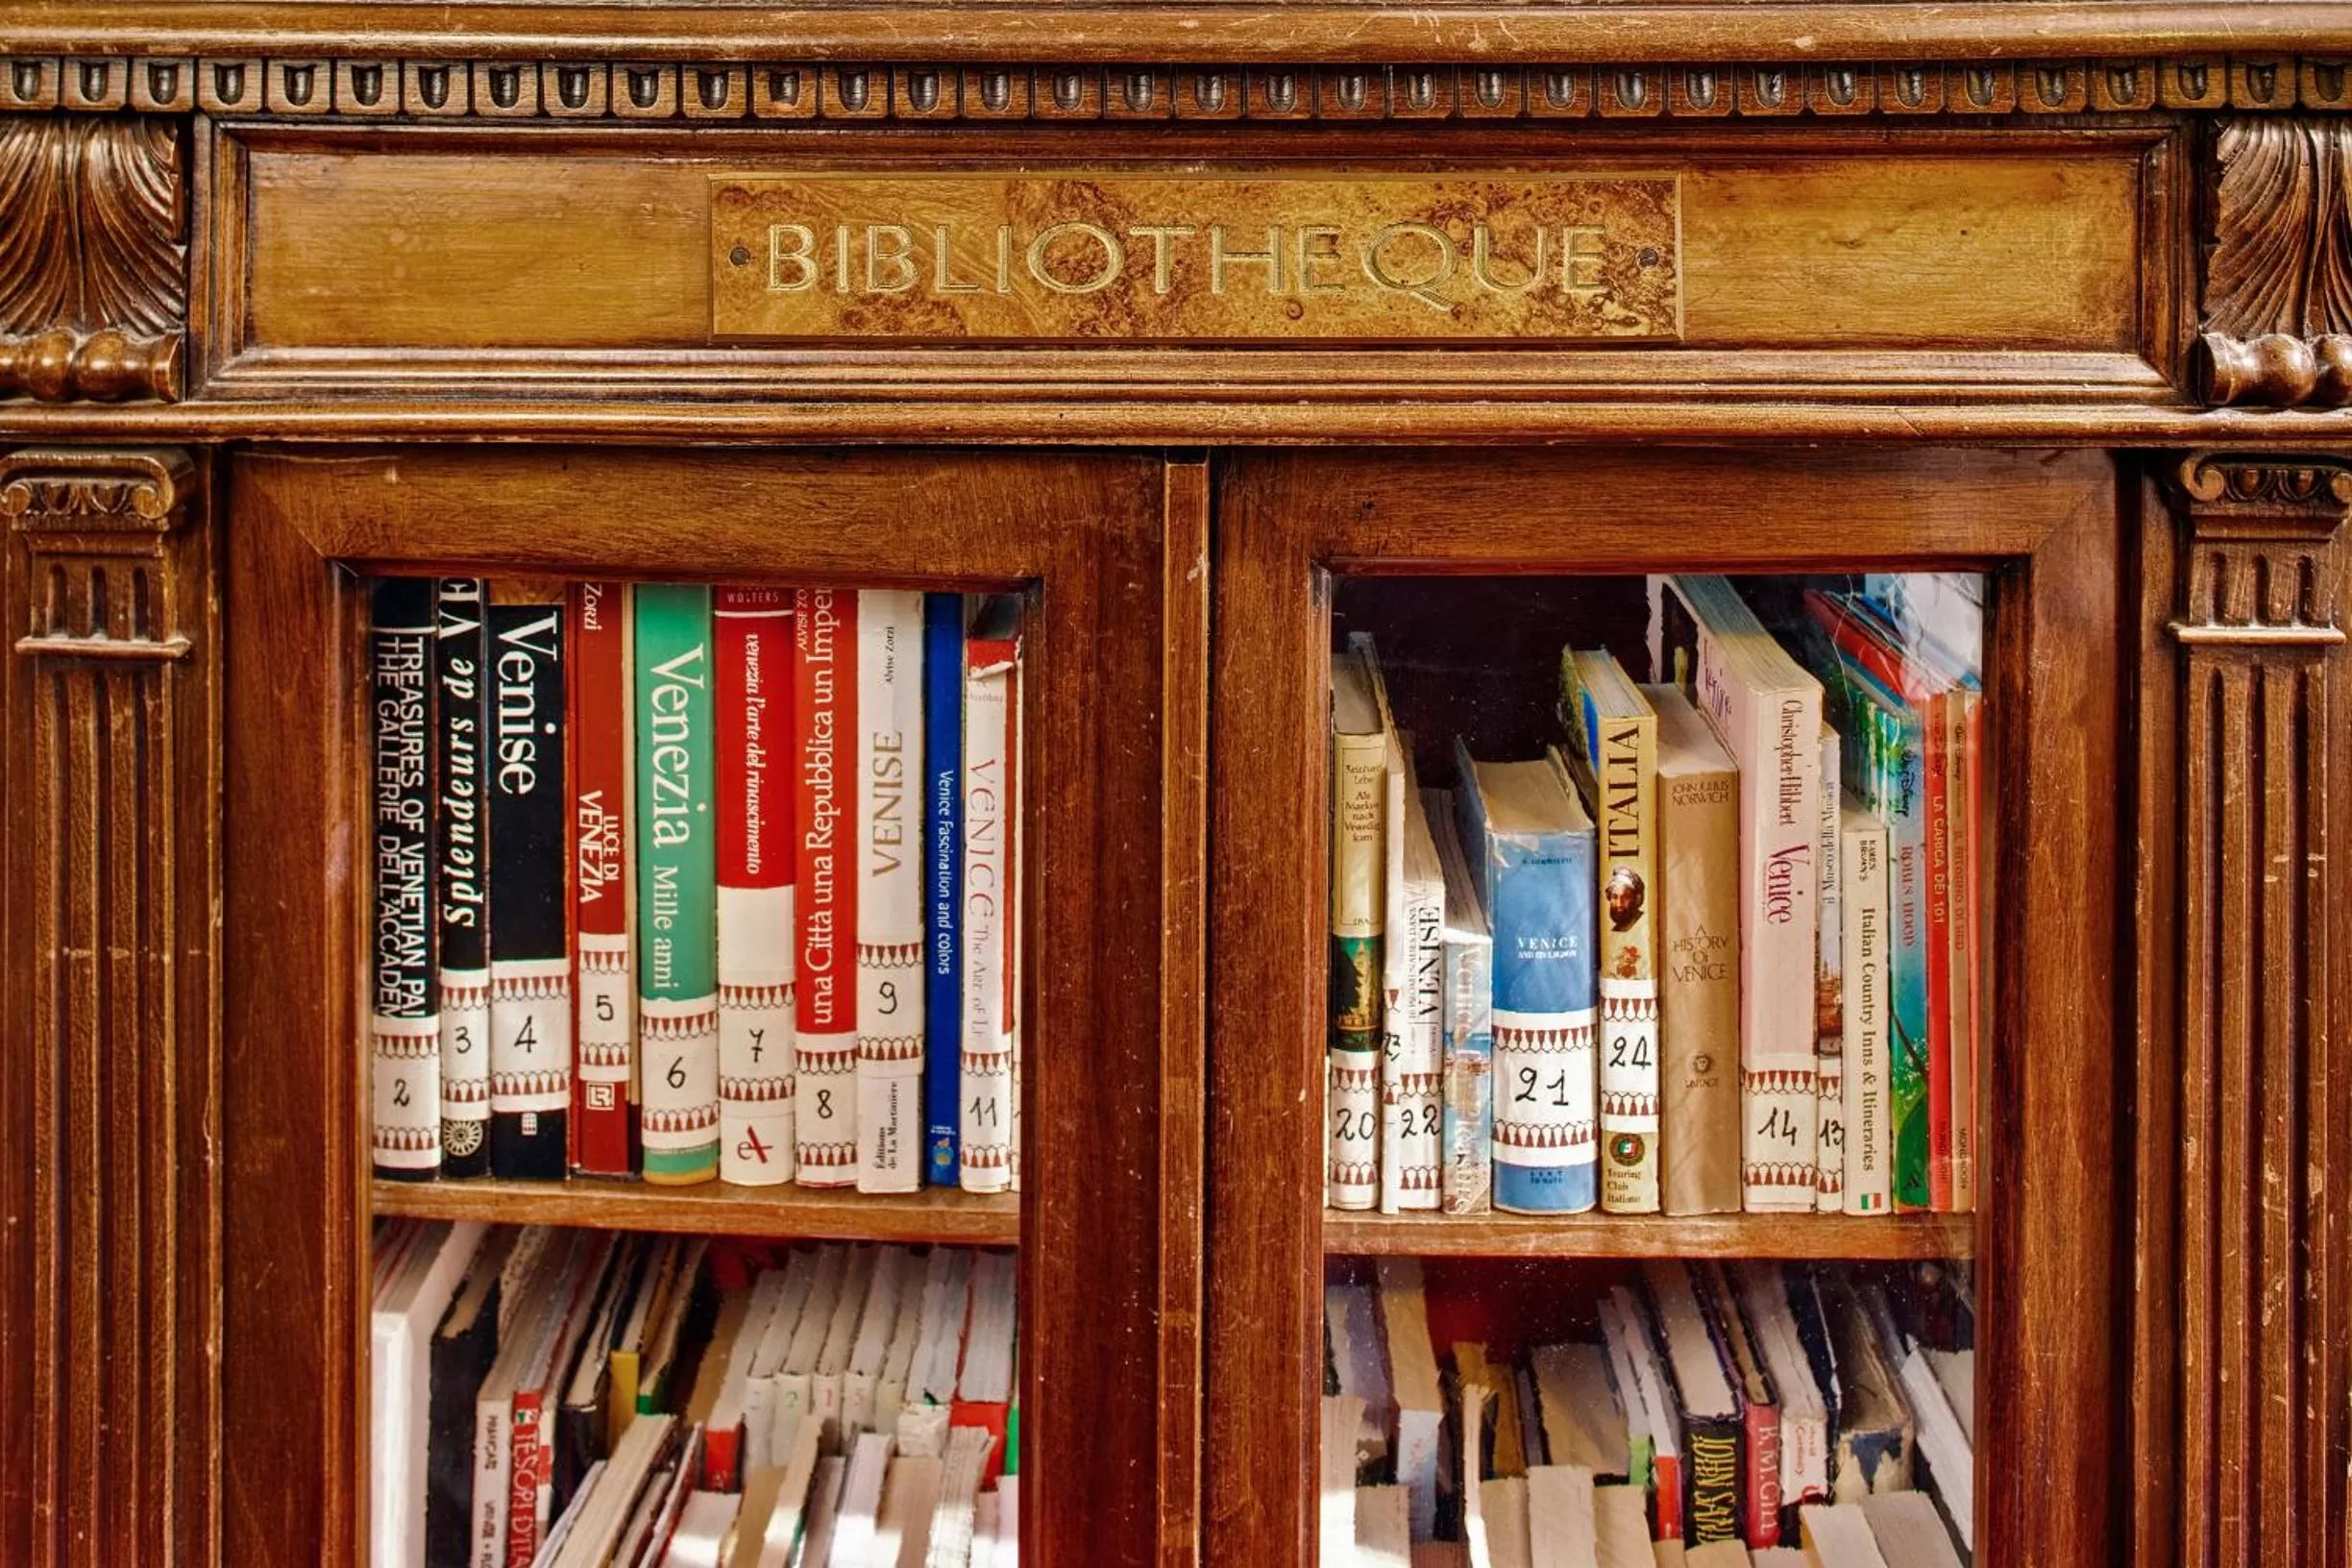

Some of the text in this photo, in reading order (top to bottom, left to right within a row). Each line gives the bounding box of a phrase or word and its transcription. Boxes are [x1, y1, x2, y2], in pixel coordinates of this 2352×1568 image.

[768, 220, 1607, 312] BIBLIOTHEQUE
[378, 636, 401, 687] THE
[442, 658, 475, 699] de
[814, 669, 834, 703] un
[400, 636, 425, 788] TREASURES
[497, 611, 557, 796] Venise
[378, 700, 401, 823] GALLERIE
[804, 710, 841, 848] Repubblica
[1774, 699, 1804, 827] Christopher Hibbert
[400, 799, 425, 833] OF
[650, 643, 707, 991] Venezia Mille anni
[872, 731, 903, 877] VENISE
[1606, 723, 1641, 861] ITALIA
[1672, 791, 1729, 805] NORWICH
[442, 718, 482, 927] Splendeurs
[579, 790, 603, 903] VENEZIA
[603, 815, 620, 881] LUCE DI
[814, 853, 833, 904] una
[938, 770, 955, 975] Venice Fascination and colors
[1766, 844, 1811, 925] Venice
[1932, 796, 1945, 923] LA CARICA DEI 101
[400, 843, 426, 967] VENETIAN
[1695, 922, 1707, 936] A
[1900, 903, 1915, 947] HOOD
[804, 911, 833, 970] Città
[1517, 935, 1579, 950] VENICE
[1673, 936, 1728, 953] HISTORY
[1862, 907, 1876, 958] Italian
[1418, 906, 1441, 1017] VENISE
[1673, 963, 1727, 983] VENICE
[594, 993, 615, 1021] 5
[814, 976, 833, 1025] una
[877, 981, 897, 1015] 9
[1860, 962, 1876, 1024] Country
[453, 1025, 472, 1055] 3
[513, 1015, 538, 1054] 4
[748, 1028, 765, 1063] 7
[1607, 1035, 1654, 1071] 24
[1862, 1029, 1876, 1066] Inns
[392, 1077, 411, 1108] 2
[666, 1056, 687, 1089] 6
[1514, 1066, 1571, 1107] 21
[817, 1089, 834, 1118] 8
[969, 1095, 997, 1127] 11
[1335, 1107, 1377, 1141] 20
[1400, 1103, 1442, 1139] 22
[1757, 1106, 1799, 1146] 14
[1862, 1090, 1877, 1172] Itineraries
[511, 1428, 538, 1508] TESORI
[1691, 1433, 1737, 1487] JOHN
[1758, 1482, 1780, 1536] GILL
